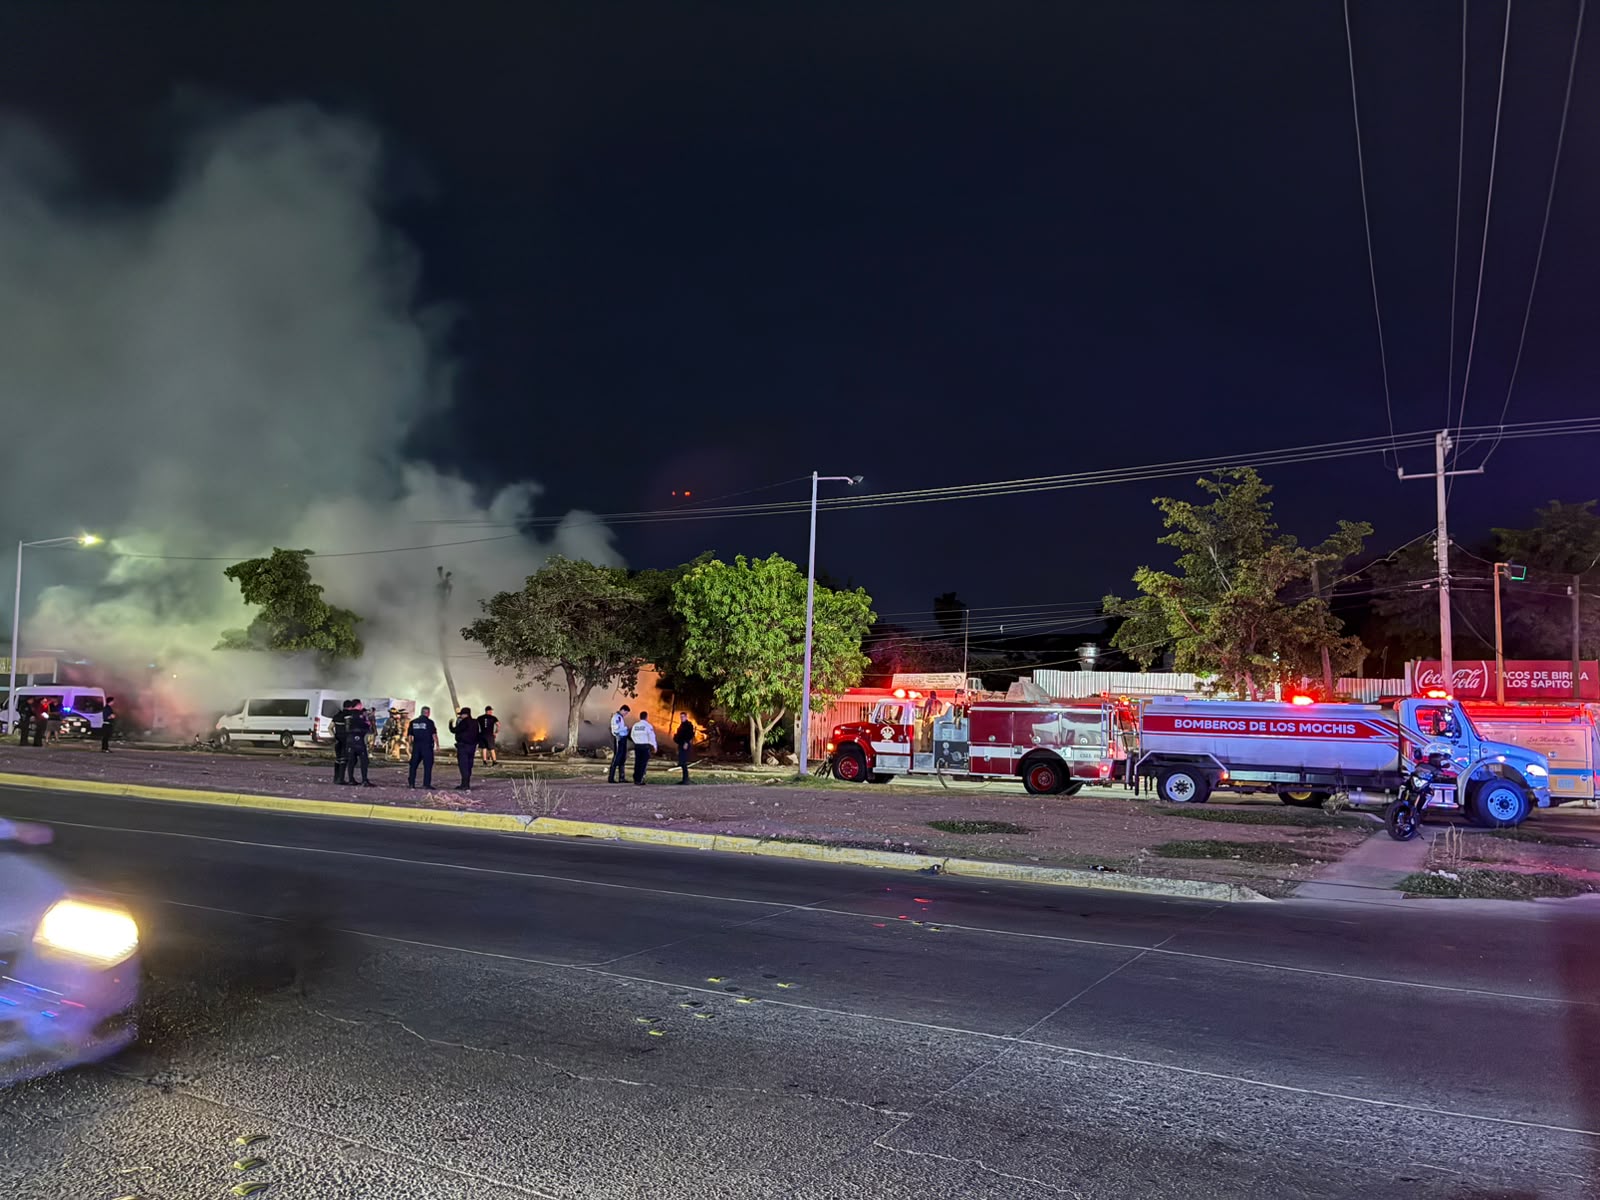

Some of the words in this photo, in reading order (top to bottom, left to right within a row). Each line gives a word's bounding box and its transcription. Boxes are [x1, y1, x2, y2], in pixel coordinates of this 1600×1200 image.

[1494, 671, 1531, 680] ACOS
[1533, 671, 1548, 680] DE
[1551, 671, 1589, 681] BIRA
[1506, 679, 1528, 689] LOS
[1174, 719, 1246, 731] BOMBEROS
[1249, 721, 1267, 732] DE
[1269, 722, 1296, 733] LOS
[1299, 723, 1356, 735] MOCHIS
